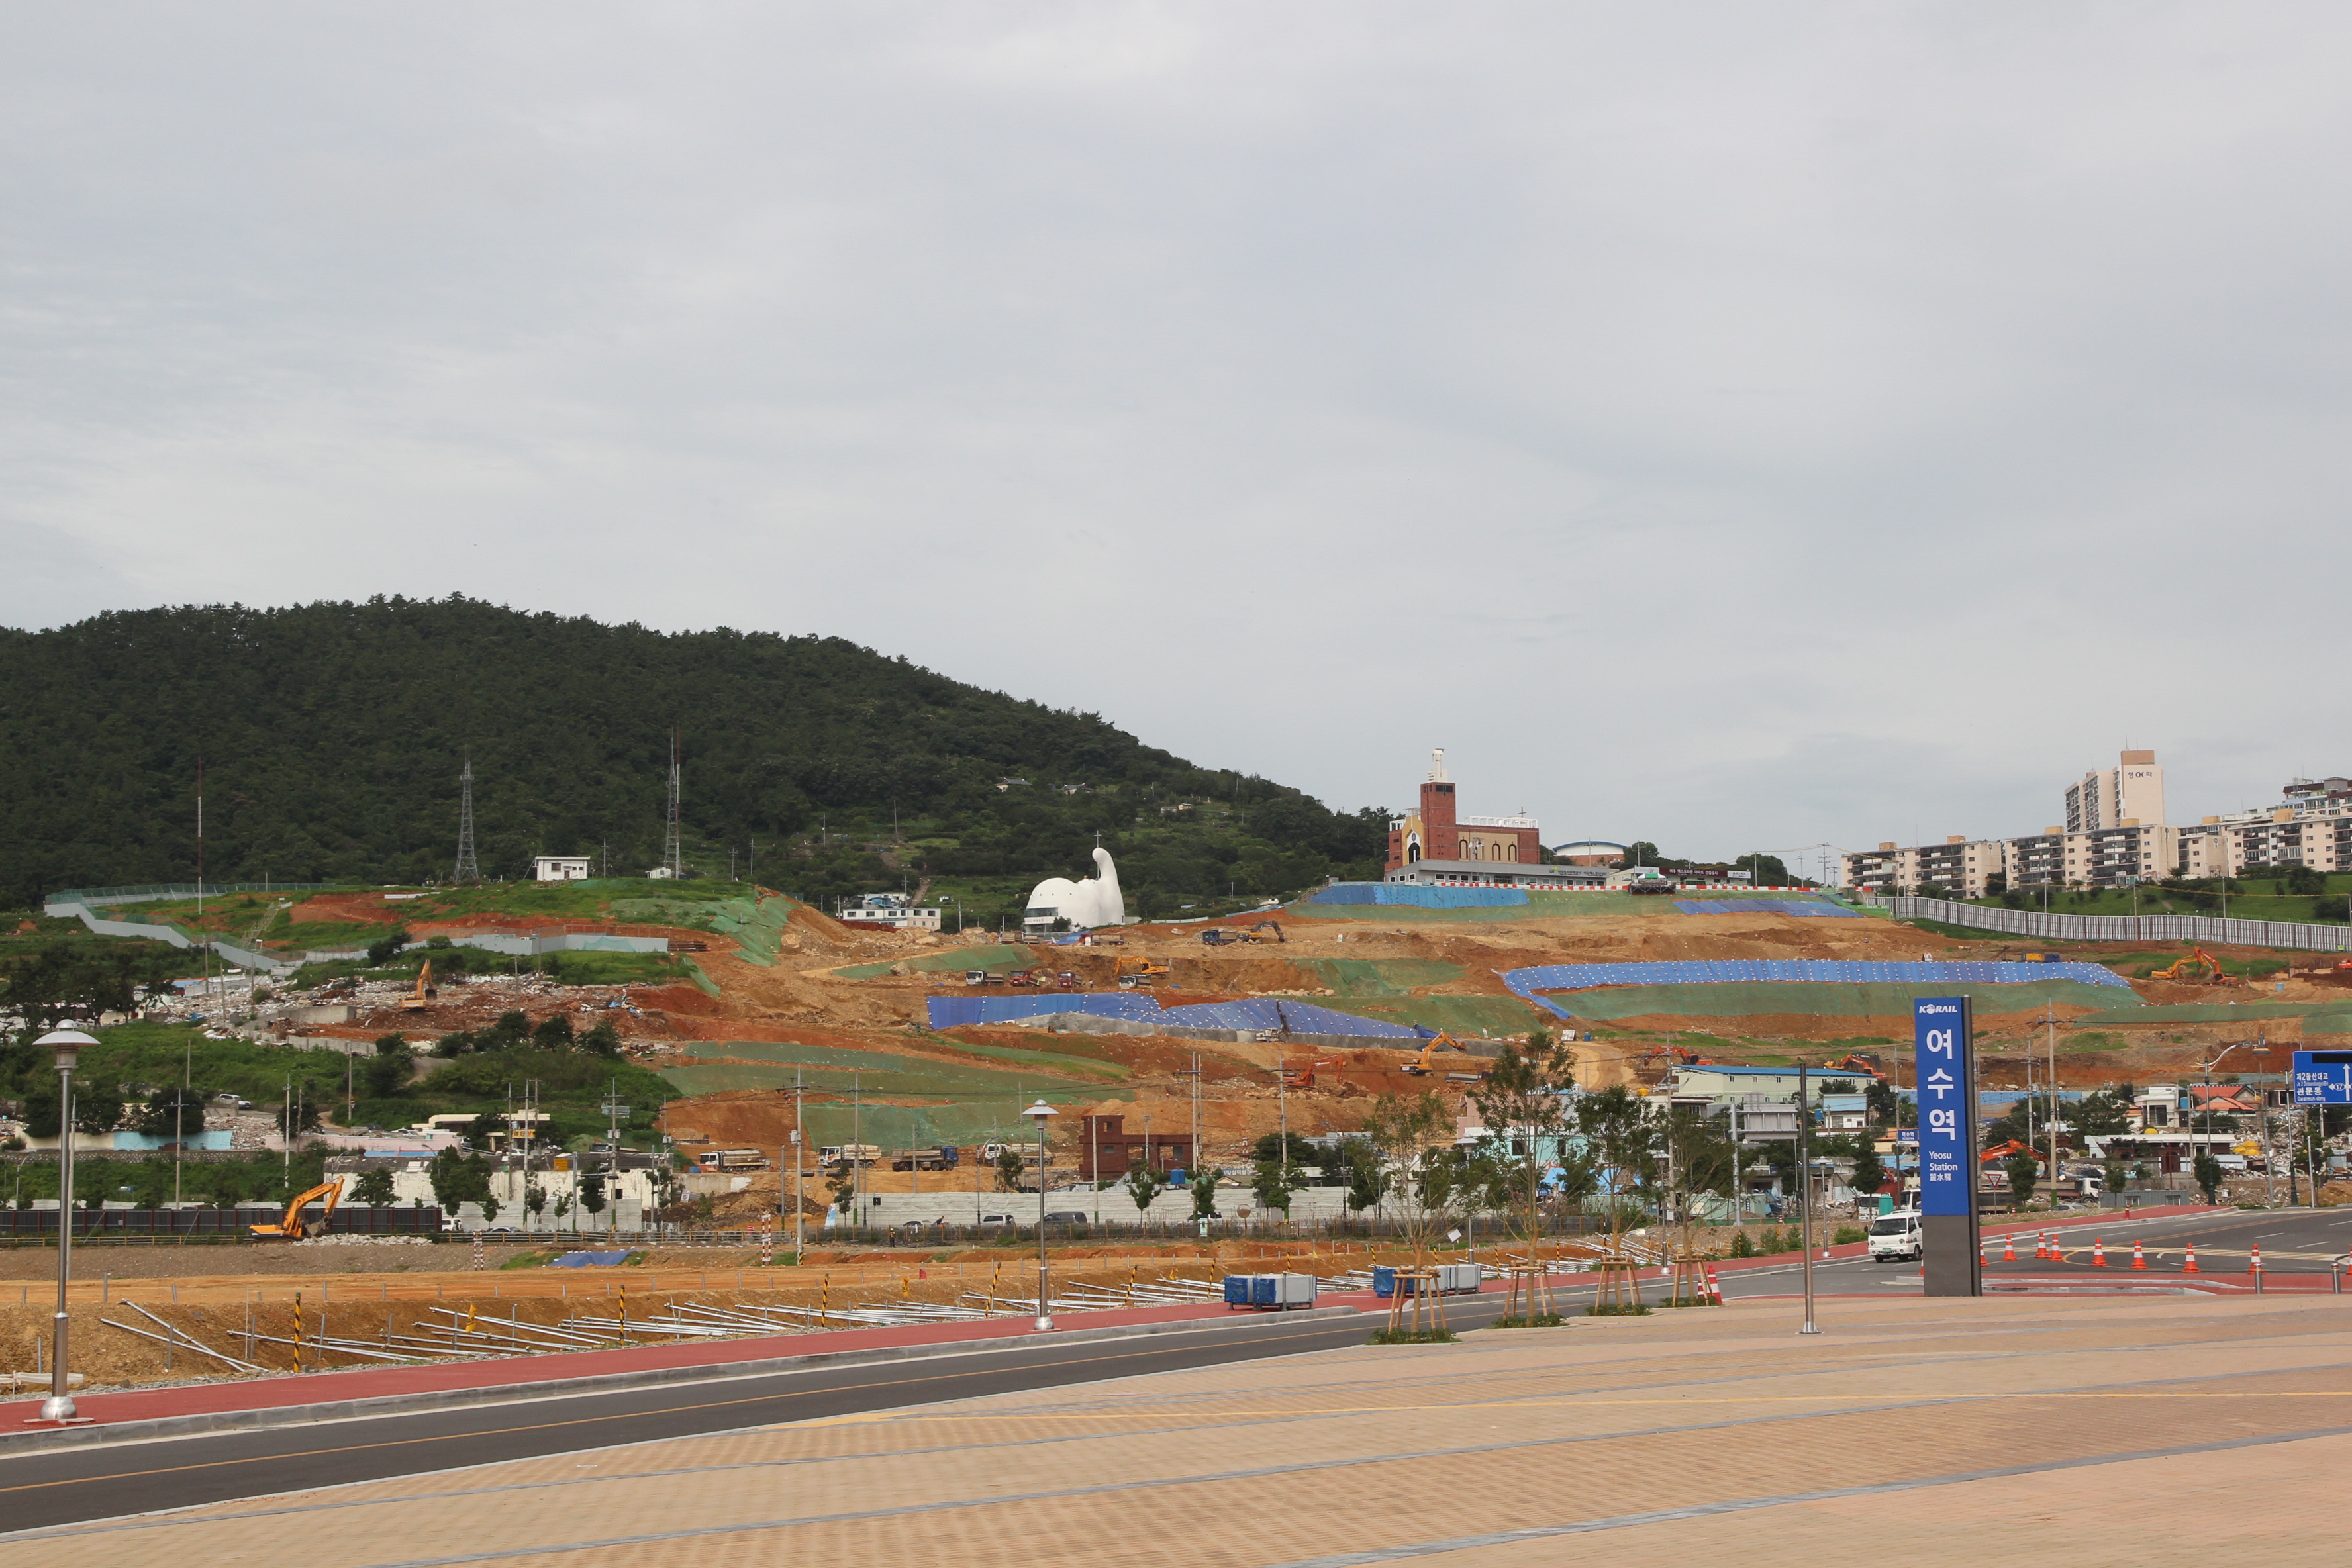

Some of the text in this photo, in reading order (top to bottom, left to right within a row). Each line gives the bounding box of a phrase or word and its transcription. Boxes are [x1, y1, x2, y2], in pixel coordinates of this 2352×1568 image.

[1918, 1004, 1958, 1014] KORAIL
[2296, 1072, 2329, 1081] 제2돌산대교
[2296, 1087, 2322, 1096] 관문동
[1928, 1151, 1952, 1159] Yeosu
[1929, 1162, 1958, 1171] Station
